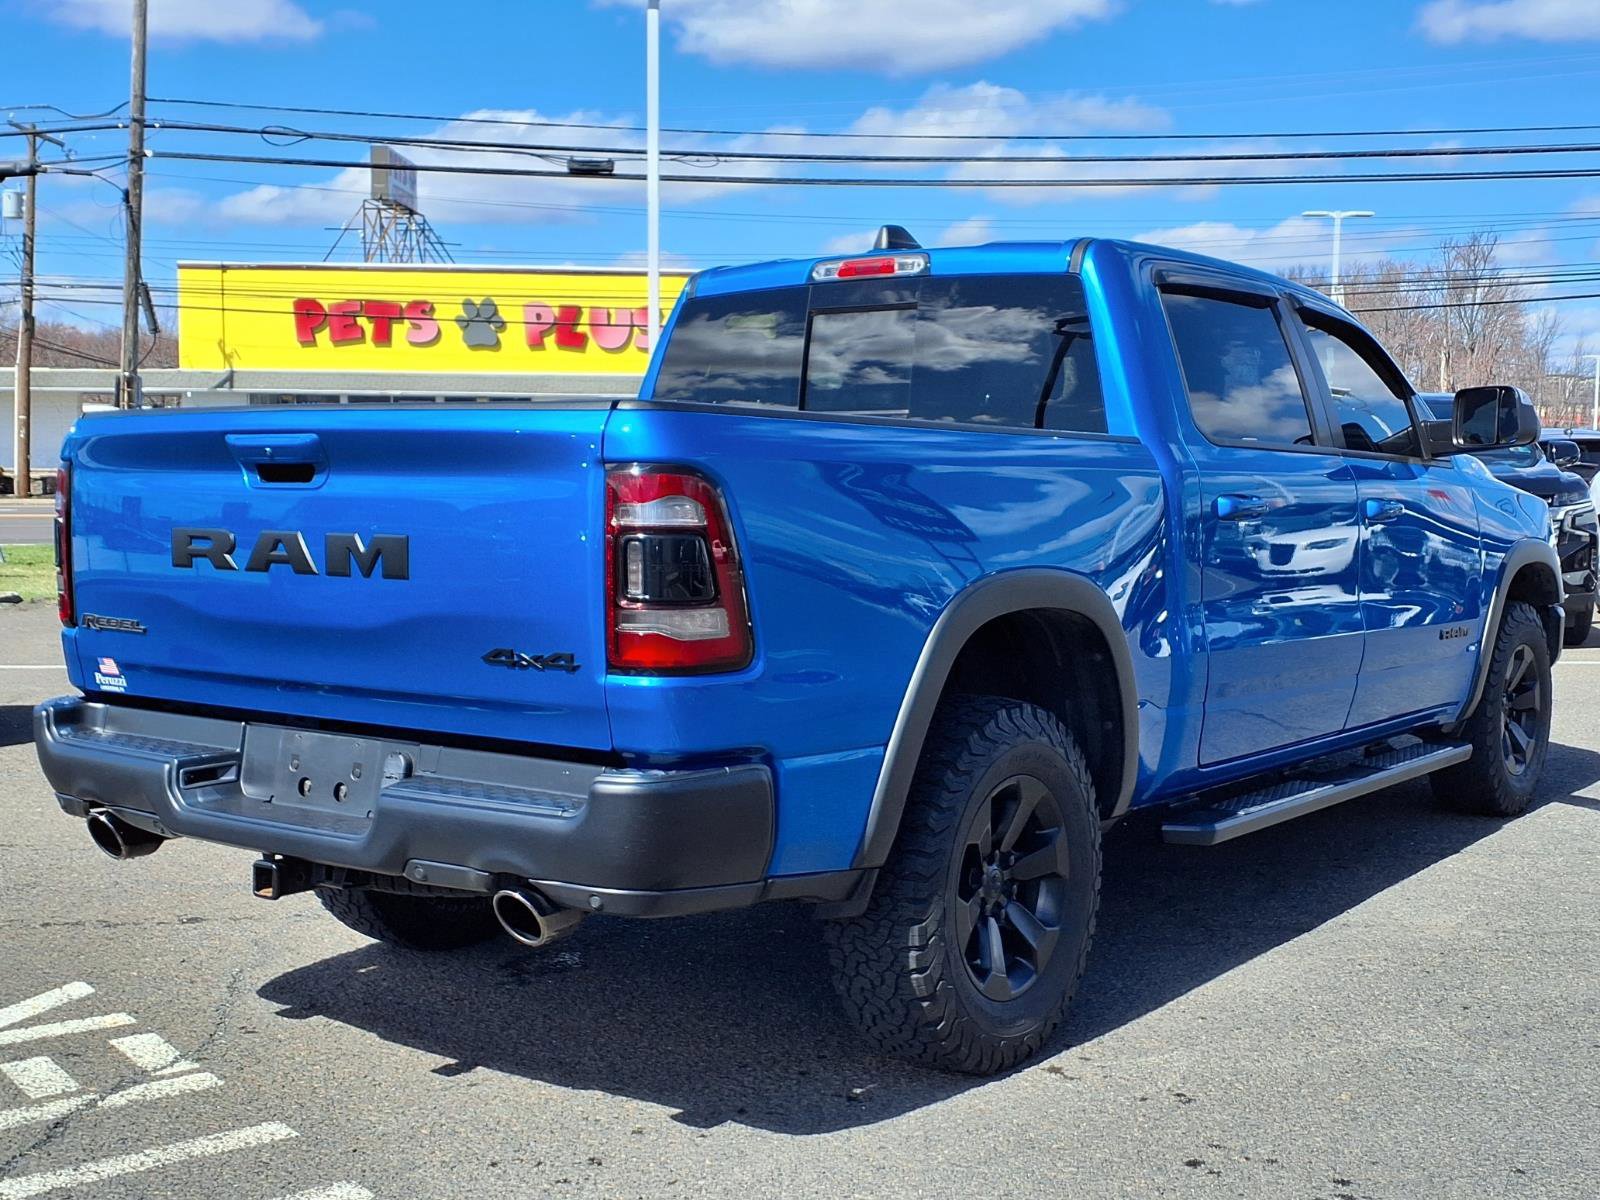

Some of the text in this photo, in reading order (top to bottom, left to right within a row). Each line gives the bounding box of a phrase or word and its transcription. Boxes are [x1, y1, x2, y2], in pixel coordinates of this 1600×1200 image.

[293, 298, 441, 347] PETS
[171, 527, 409, 580] RAM
[82, 613, 147, 634] REBEL
